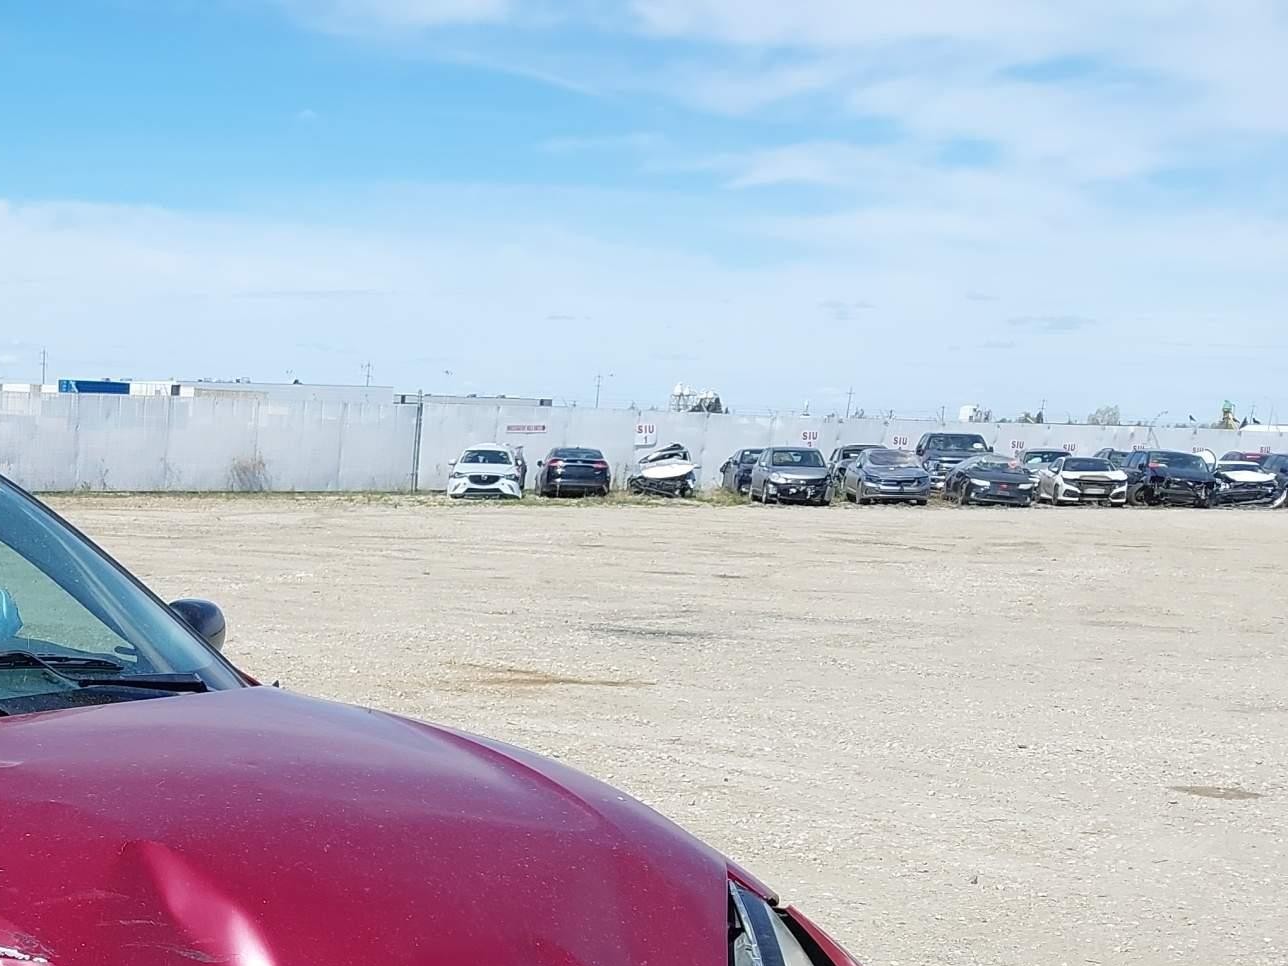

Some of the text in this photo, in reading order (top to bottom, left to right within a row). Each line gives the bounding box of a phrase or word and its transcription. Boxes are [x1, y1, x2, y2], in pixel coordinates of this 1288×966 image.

[637, 424, 654, 434] SIU
[802, 431, 818, 440] SIU
[893, 436, 908, 445] SIU
[1011, 440, 1025, 449] SIU
